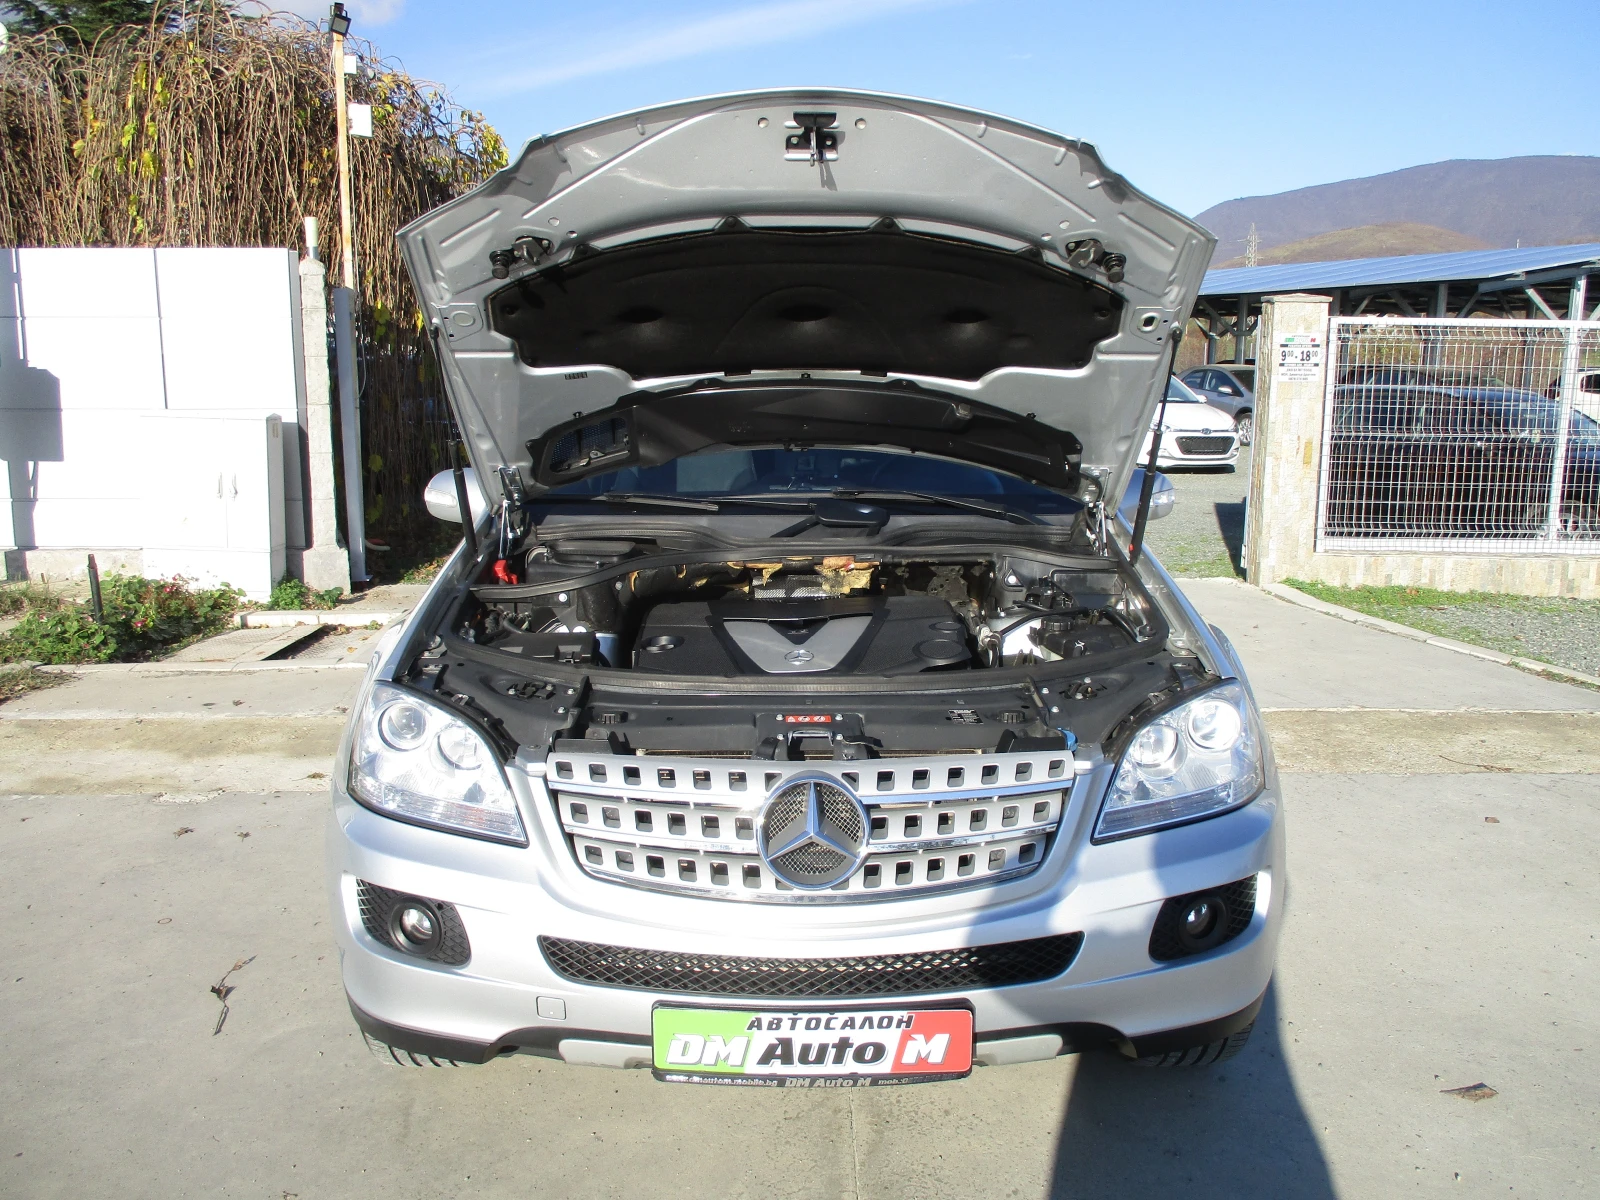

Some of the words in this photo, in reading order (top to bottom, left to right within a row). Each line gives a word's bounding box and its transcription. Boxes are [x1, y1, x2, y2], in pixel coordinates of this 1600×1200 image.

[749, 1015, 913, 1032] АВТОСАЛОН
[665, 1033, 749, 1066] DM
[756, 1036, 888, 1067] Auto
[900, 1033, 952, 1065] M
[784, 1077, 810, 1087] DM
[812, 1077, 854, 1088] Auto
[856, 1077, 872, 1087] M
